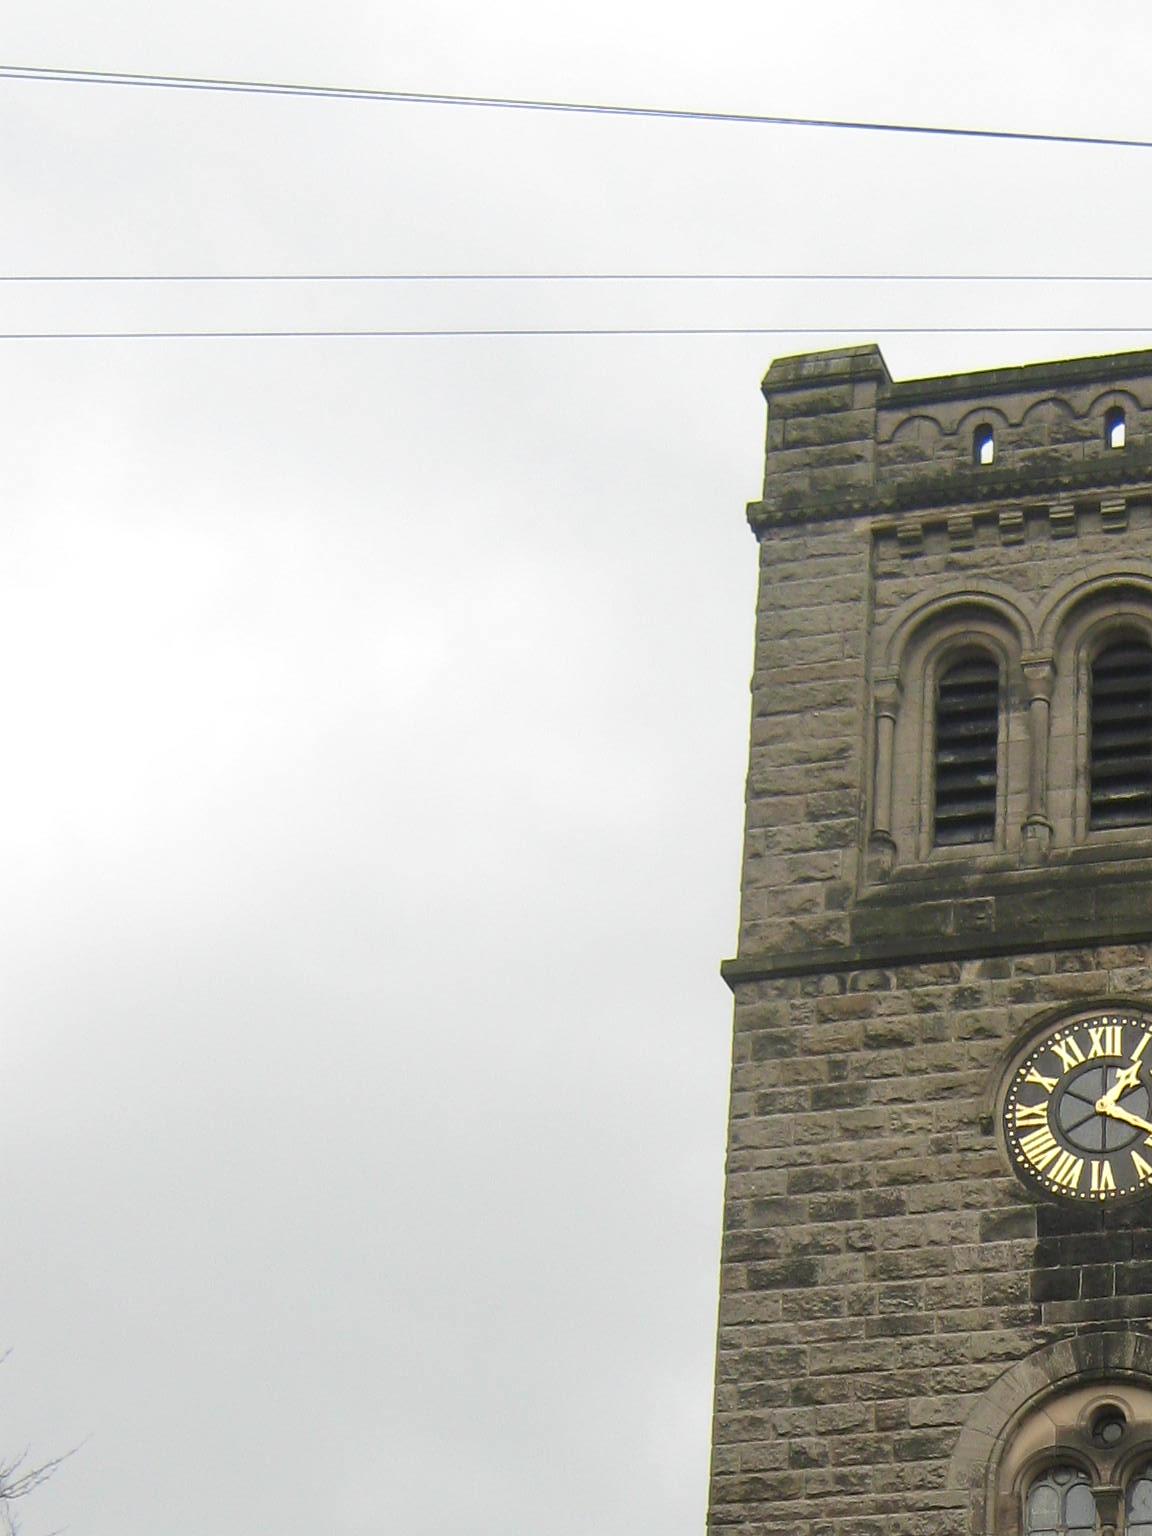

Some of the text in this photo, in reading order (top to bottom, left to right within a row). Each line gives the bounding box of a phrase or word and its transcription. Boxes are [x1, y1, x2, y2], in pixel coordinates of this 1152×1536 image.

[1050, 1035, 1086, 1074] XI
[1087, 1026, 1123, 1059] XII
[1130, 1032, 1152, 1062] I
[1025, 1067, 1059, 1094] X
[1016, 1100, 1048, 1127] IX
[1090, 1160, 1116, 1191] VI
